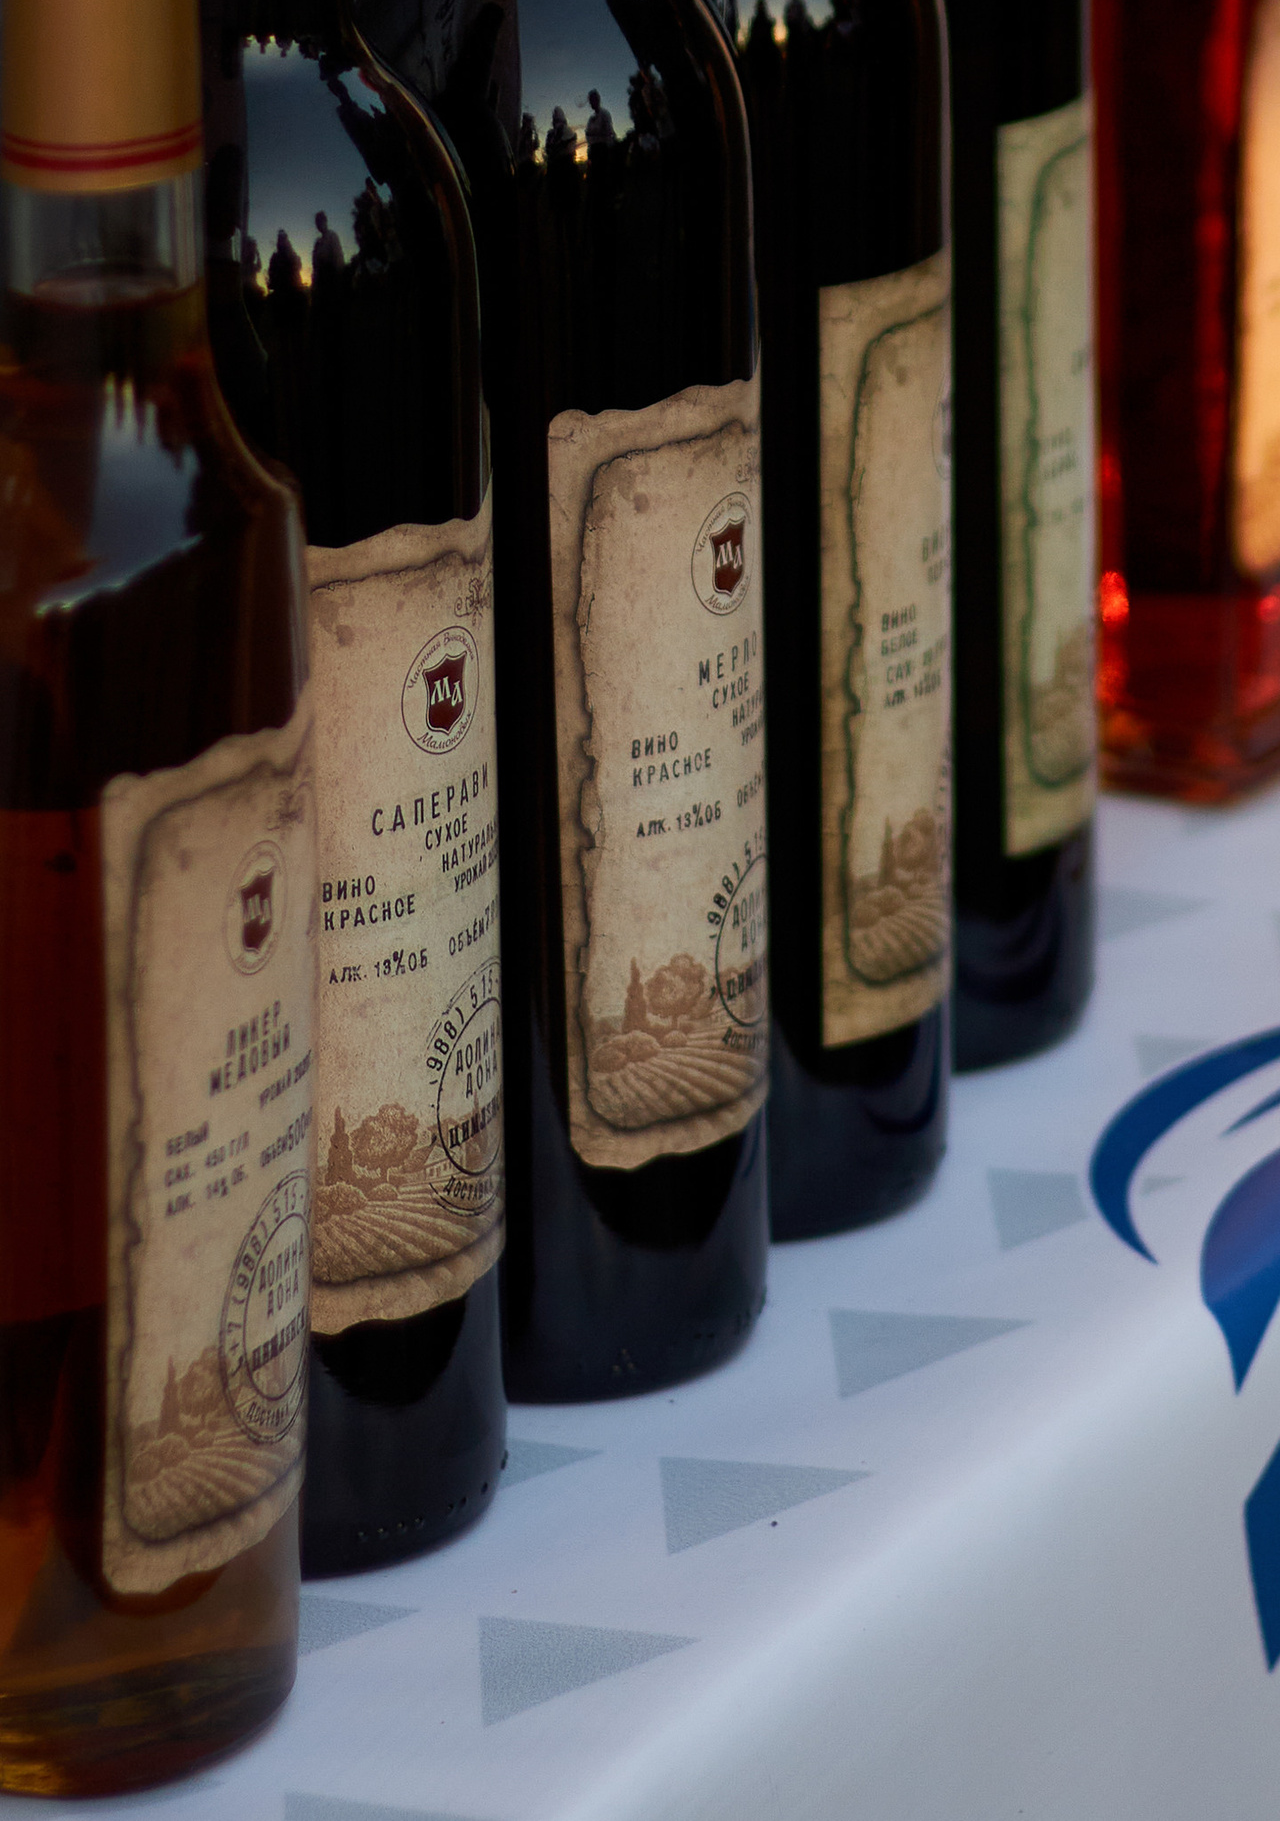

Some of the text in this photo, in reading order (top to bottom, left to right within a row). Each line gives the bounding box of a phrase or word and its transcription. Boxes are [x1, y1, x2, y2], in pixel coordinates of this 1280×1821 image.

[698, 630, 758, 686] МЕРЛО
[712, 671, 749, 709] СУХОЕ
[631, 730, 679, 759] ВИНО
[632, 747, 712, 787] КРАСНОЕ
[371, 762, 489, 836] САПЕРАВИ
[424, 812, 468, 850] СУХОЕ
[636, 817, 672, 838] АЛК.
[322, 875, 376, 903] ВИНО
[324, 893, 416, 931] КРАСНОЕ
[329, 964, 368, 985] АЛК.
[464, 1050, 498, 1099] ДОНА
[257, 1232, 304, 1293] ДОЛИНА
[265, 1268, 299, 1319] ДОНА
